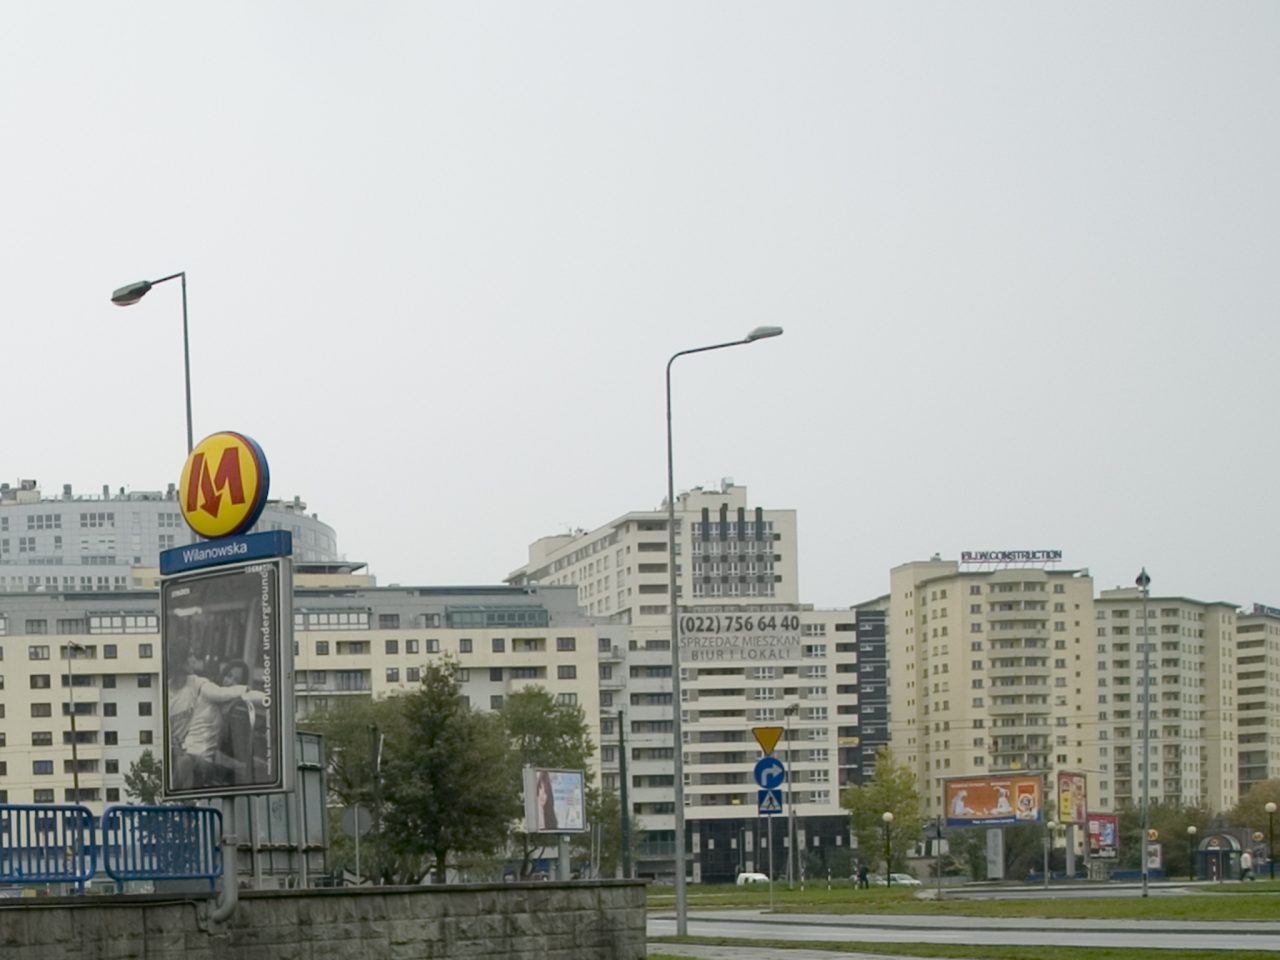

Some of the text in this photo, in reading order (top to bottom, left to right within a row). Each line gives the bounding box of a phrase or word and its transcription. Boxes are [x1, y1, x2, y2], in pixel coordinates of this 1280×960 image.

[182, 541, 248, 564] Wilanowska
[260, 569, 272, 650] underground
[679, 615, 800, 635] (022) 756 64 40
[691, 649, 724, 661] BIUR
[740, 647, 790, 660] LOKALI
[261, 654, 272, 707] Outdoor
